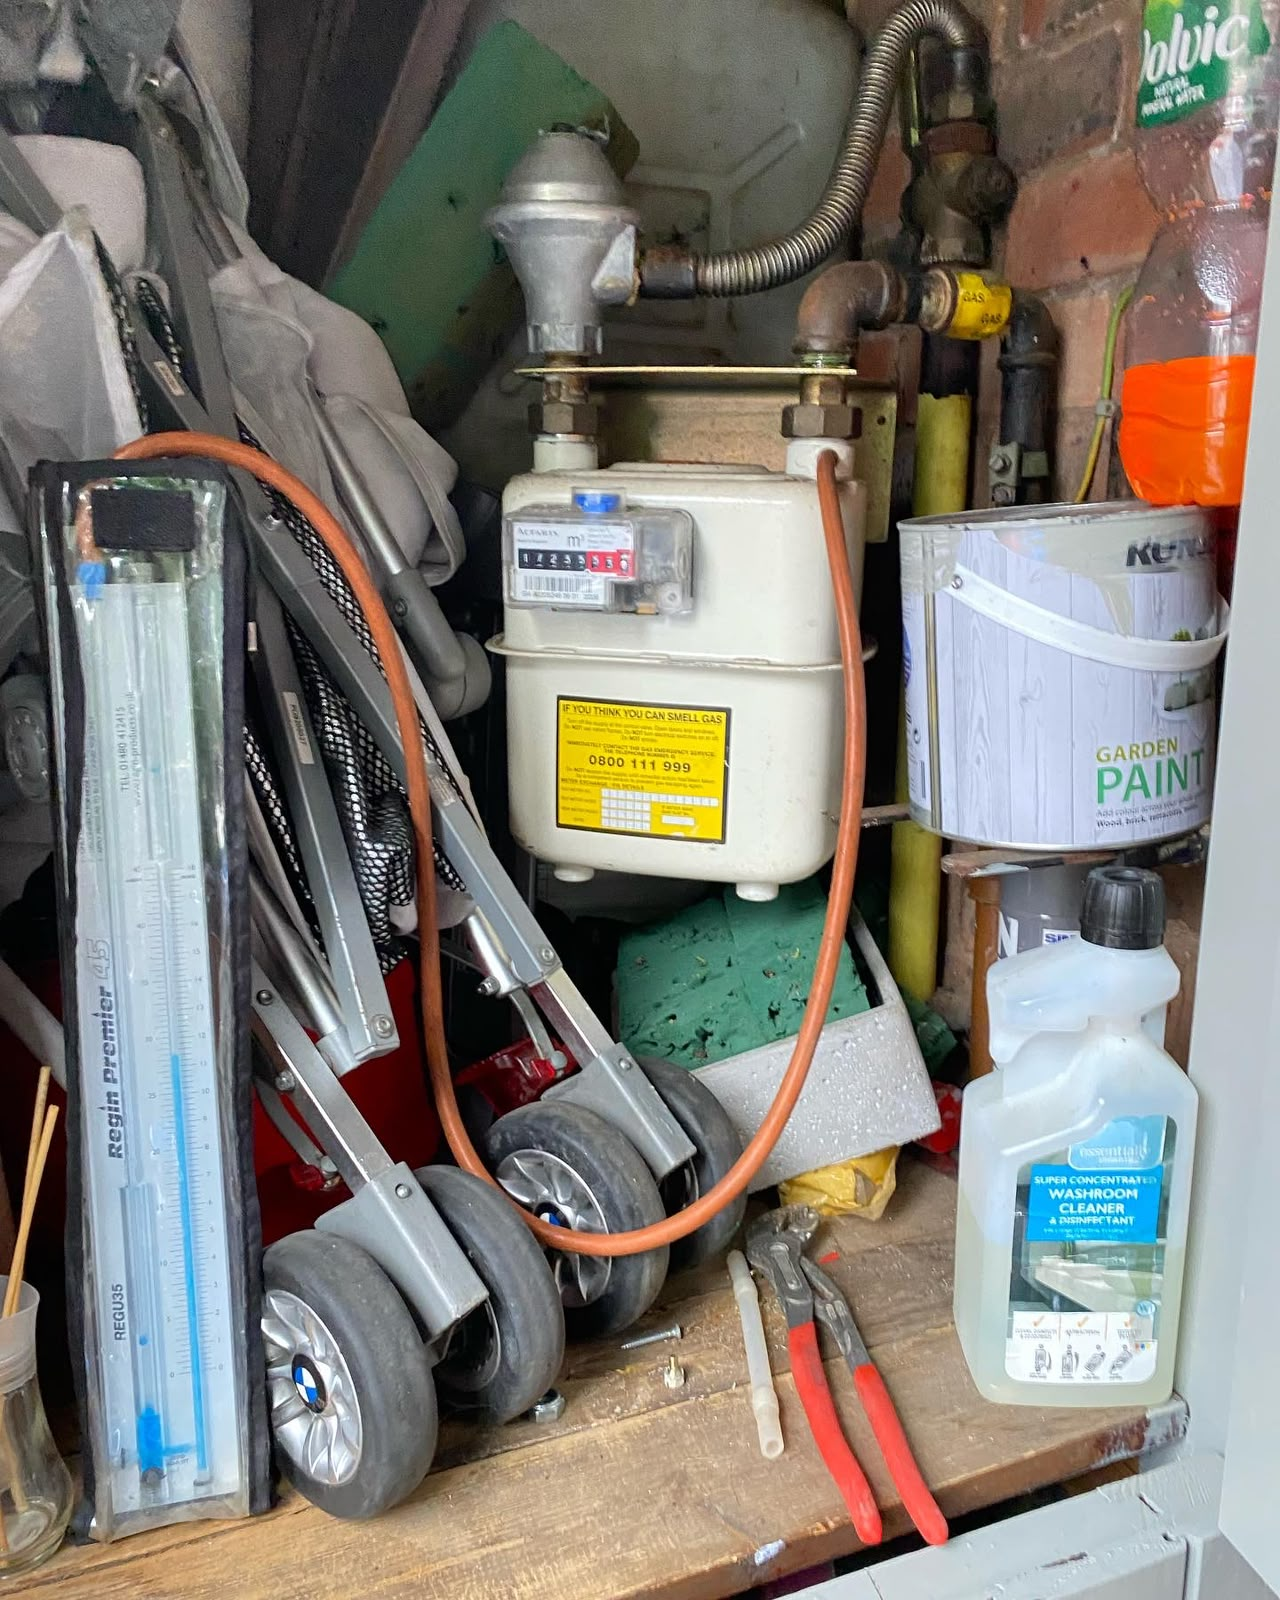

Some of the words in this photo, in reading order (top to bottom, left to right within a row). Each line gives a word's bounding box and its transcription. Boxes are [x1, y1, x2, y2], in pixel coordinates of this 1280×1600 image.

[114, 706, 126, 740] 412415
[563, 703, 570, 712] IF
[572, 704, 591, 713] YOU
[593, 705, 620, 716] THINK
[623, 708, 642, 718] YOU
[645, 710, 665, 719] CAN
[667, 712, 699, 722] SMELL
[701, 714, 721, 724] GAS
[1096, 736, 1178, 763] GARDEN
[589, 754, 624, 767] 0800
[631, 758, 655, 770] 111
[663, 760, 691, 773] 999
[1097, 748, 1205, 804] PAINT
[91, 985, 118, 1084] Premier
[98, 1090, 124, 1159] Regin
[1034, 1176, 1068, 1185] SUPER
[1069, 1175, 1157, 1185] CONCENTRATED
[1048, 1188, 1138, 1200] WASHROOM
[1059, 1202, 1125, 1214] CLEANER
[1060, 1216, 1134, 1226] DISINFECTANT
[112, 1284, 126, 1340] REGU35
